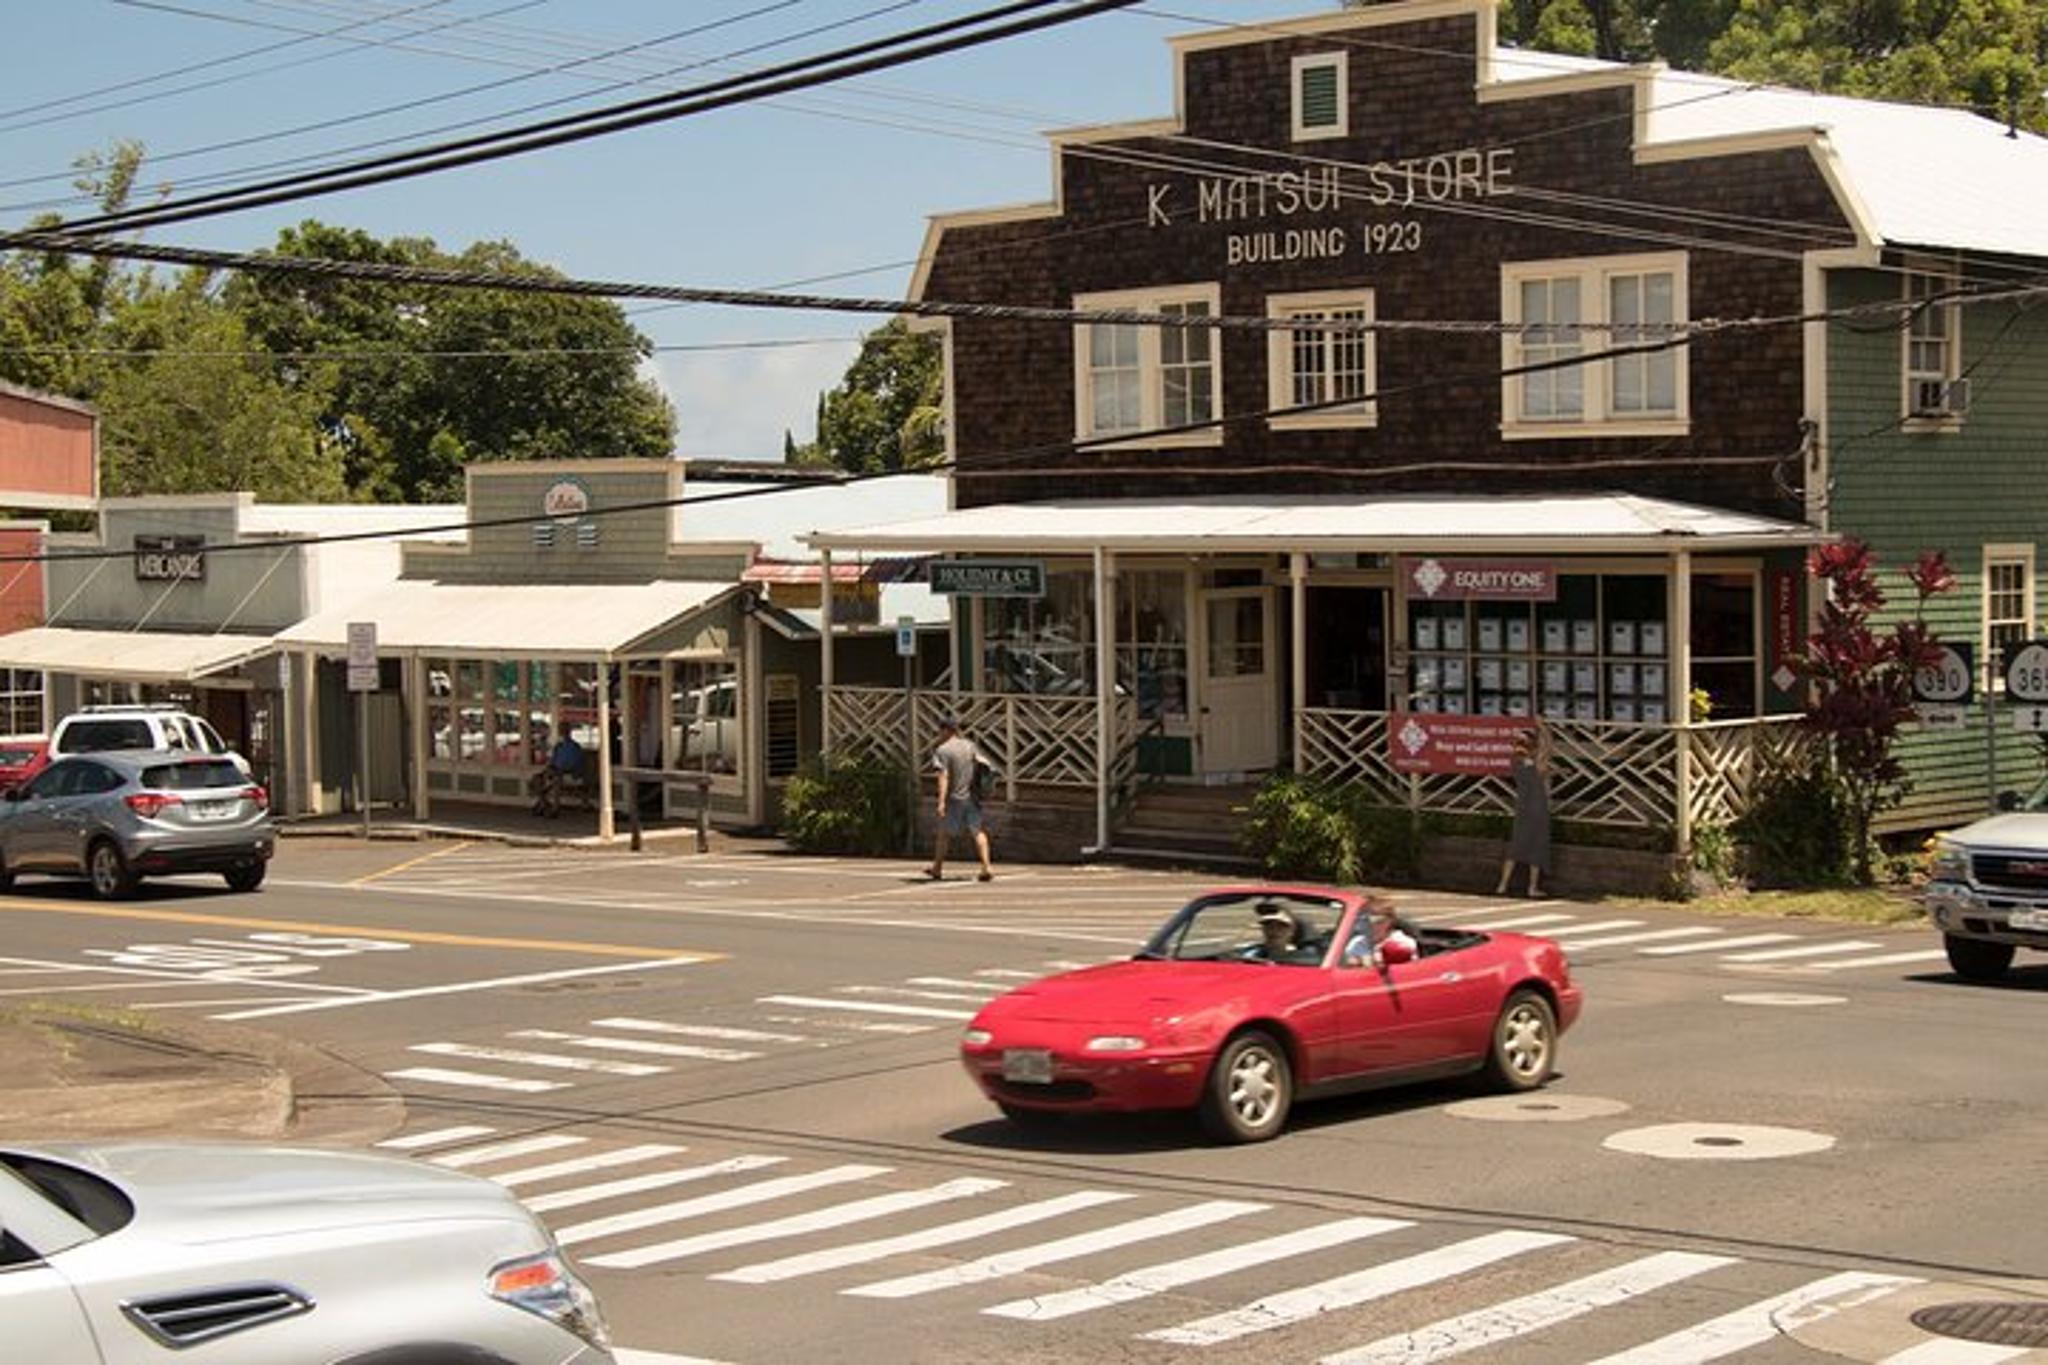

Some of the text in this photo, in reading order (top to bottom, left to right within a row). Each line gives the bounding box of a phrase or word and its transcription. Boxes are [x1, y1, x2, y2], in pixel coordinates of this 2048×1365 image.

[1149, 149, 1515, 227] K MATSUI STORE
[1227, 221, 1422, 265] BUILDING 1923
[2018, 667, 2048, 692] 36
